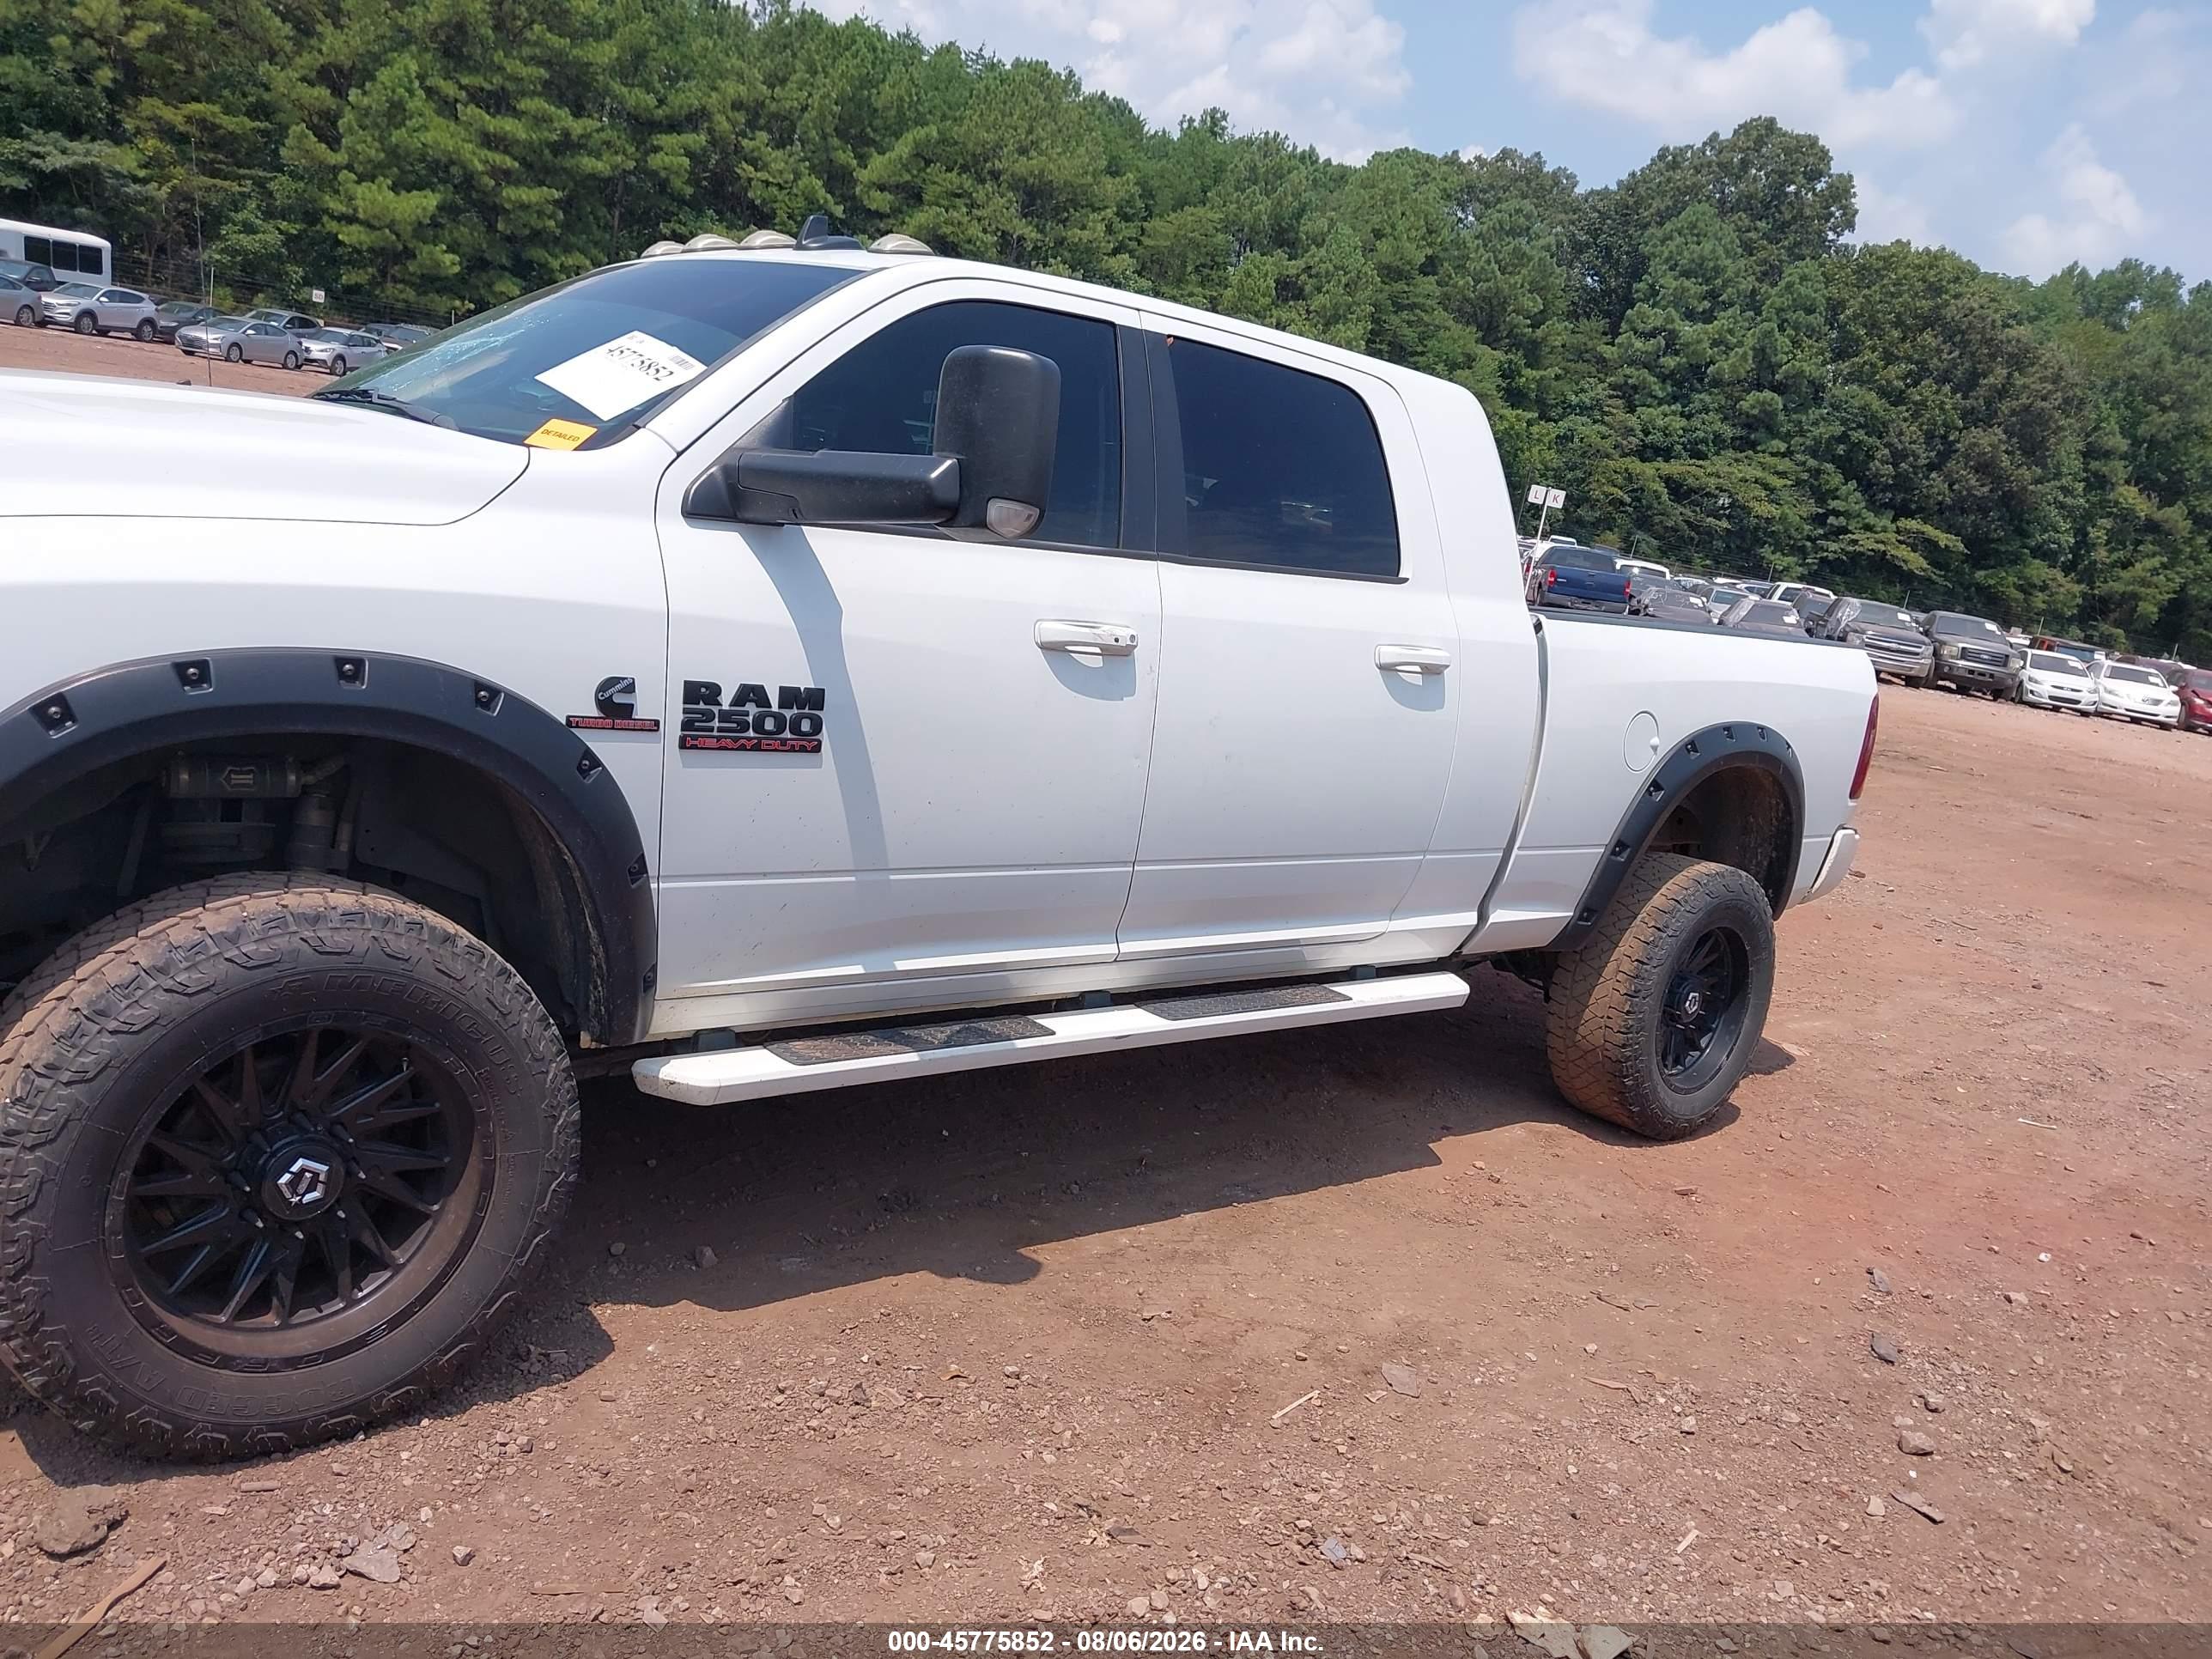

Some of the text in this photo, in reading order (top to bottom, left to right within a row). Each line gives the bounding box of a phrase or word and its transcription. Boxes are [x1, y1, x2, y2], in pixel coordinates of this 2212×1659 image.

[540, 428, 580, 443] DETAILED
[1534, 489, 1539, 499] L
[1553, 494, 1560, 504] K
[597, 677, 634, 702] Cummins
[683, 679, 825, 711] RAM
[569, 717, 659, 731] TURBO DIESEL
[681, 707, 823, 737] 2500
[686, 737, 818, 751] HEAVY DUTY
